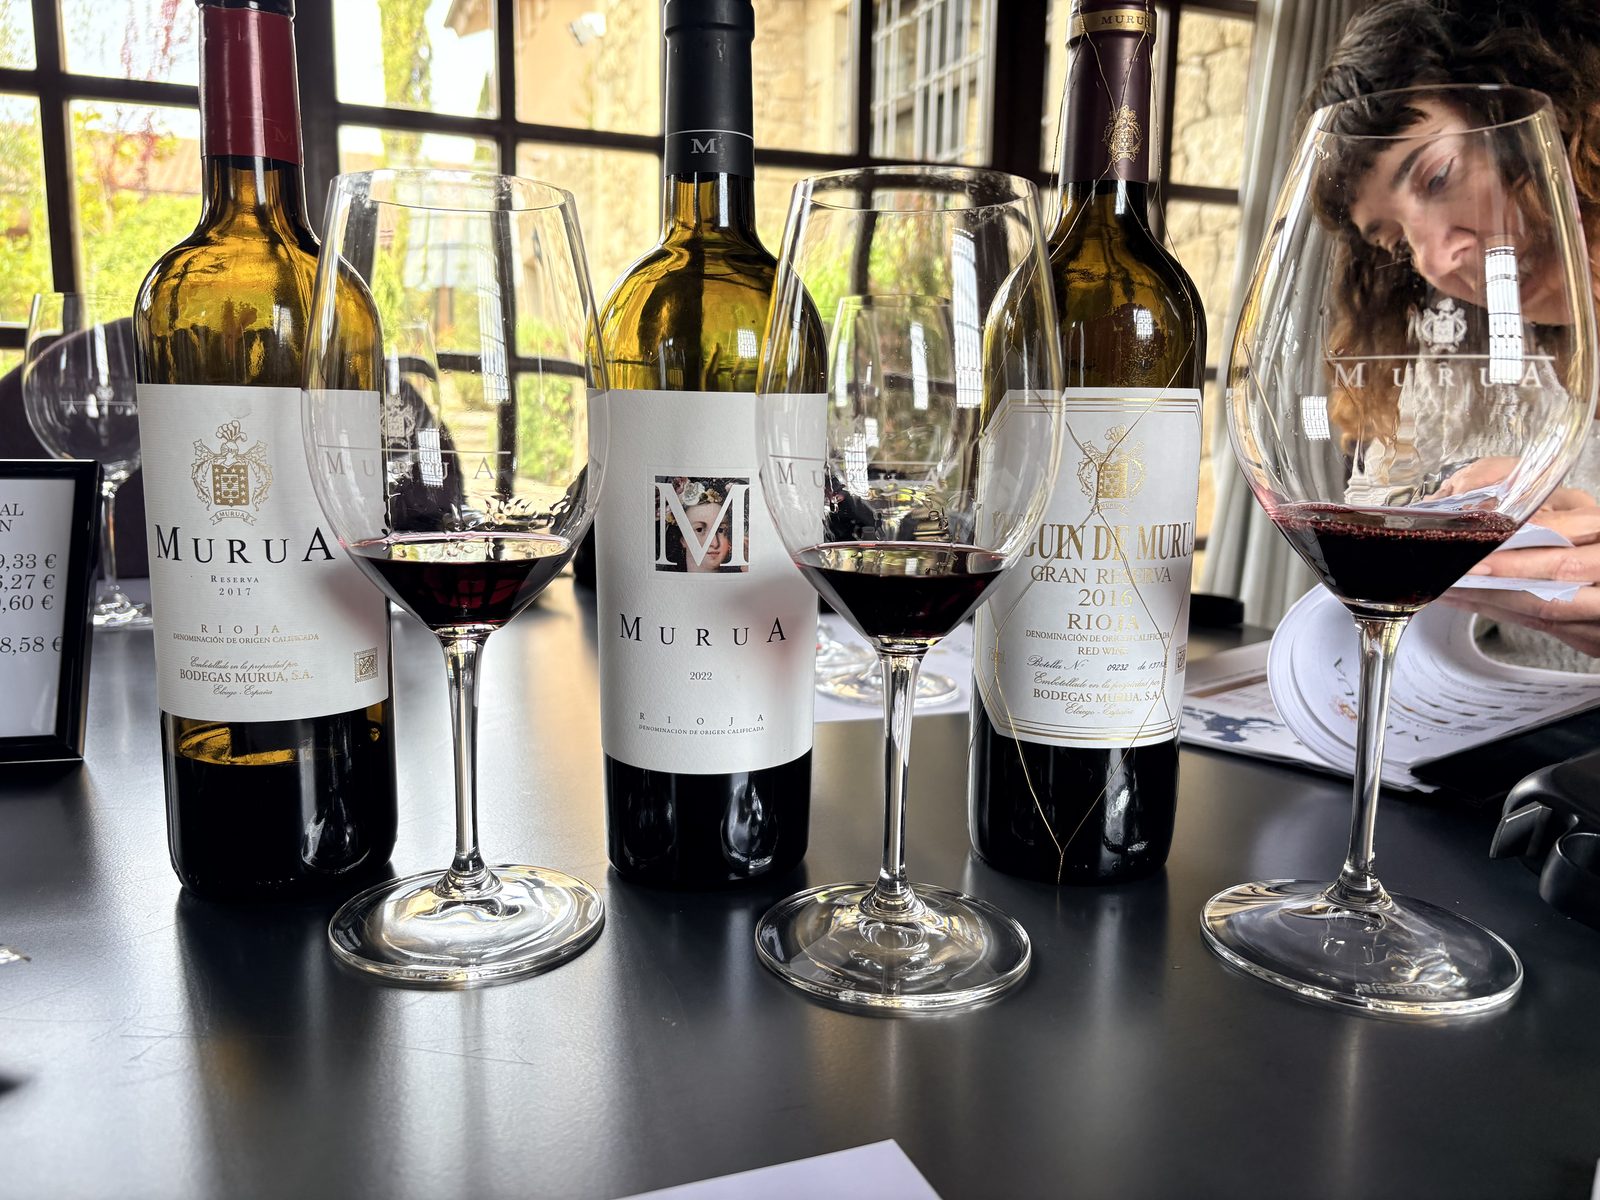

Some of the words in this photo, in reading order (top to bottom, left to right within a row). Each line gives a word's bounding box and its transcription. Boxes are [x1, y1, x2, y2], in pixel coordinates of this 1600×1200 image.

[1101, 15, 1149, 25] MURU
[690, 138, 718, 154] M
[776, 461, 945, 492] MUA
[651, 480, 750, 567] M
[154, 524, 336, 564] MURUA
[1092, 524, 1130, 561] DE
[210, 575, 260, 584] RESERVA
[1030, 565, 1087, 584] GRAN
[1095, 566, 1172, 585] RESERVA
[0, 574, 36, 592] ,27
[219, 587, 252, 597] 2017
[1078, 588, 1134, 607] 2016
[0, 595, 34, 613] ,60
[200, 623, 280, 636] RIOJA
[1067, 612, 1141, 632] RIOJA
[619, 613, 787, 647] MURUA
[1025, 629, 1088, 642] DENOMINACIÓN
[1089, 634, 1100, 642] DE
[173, 632, 225, 644] DENOMINACIÓN
[238, 636, 271, 644] ORIGEN
[272, 633, 320, 644] CALIFICADA
[1078, 646, 1100, 656] RED
[1102, 646, 1129, 656] WINE
[1026, 654, 1062, 669] Botella
[1106, 662, 1130, 672] 09232
[180, 668, 232, 683] BODEGAS
[689, 671, 713, 681] 2022
[1033, 671, 1087, 689] Embotellado
[1088, 681, 1100, 689] en
[1033, 688, 1092, 703] BODEGAS
[639, 712, 764, 726] RIOJA
[638, 724, 688, 735] DENOMINACIÓN
[727, 726, 765, 735] CALIFICADA
